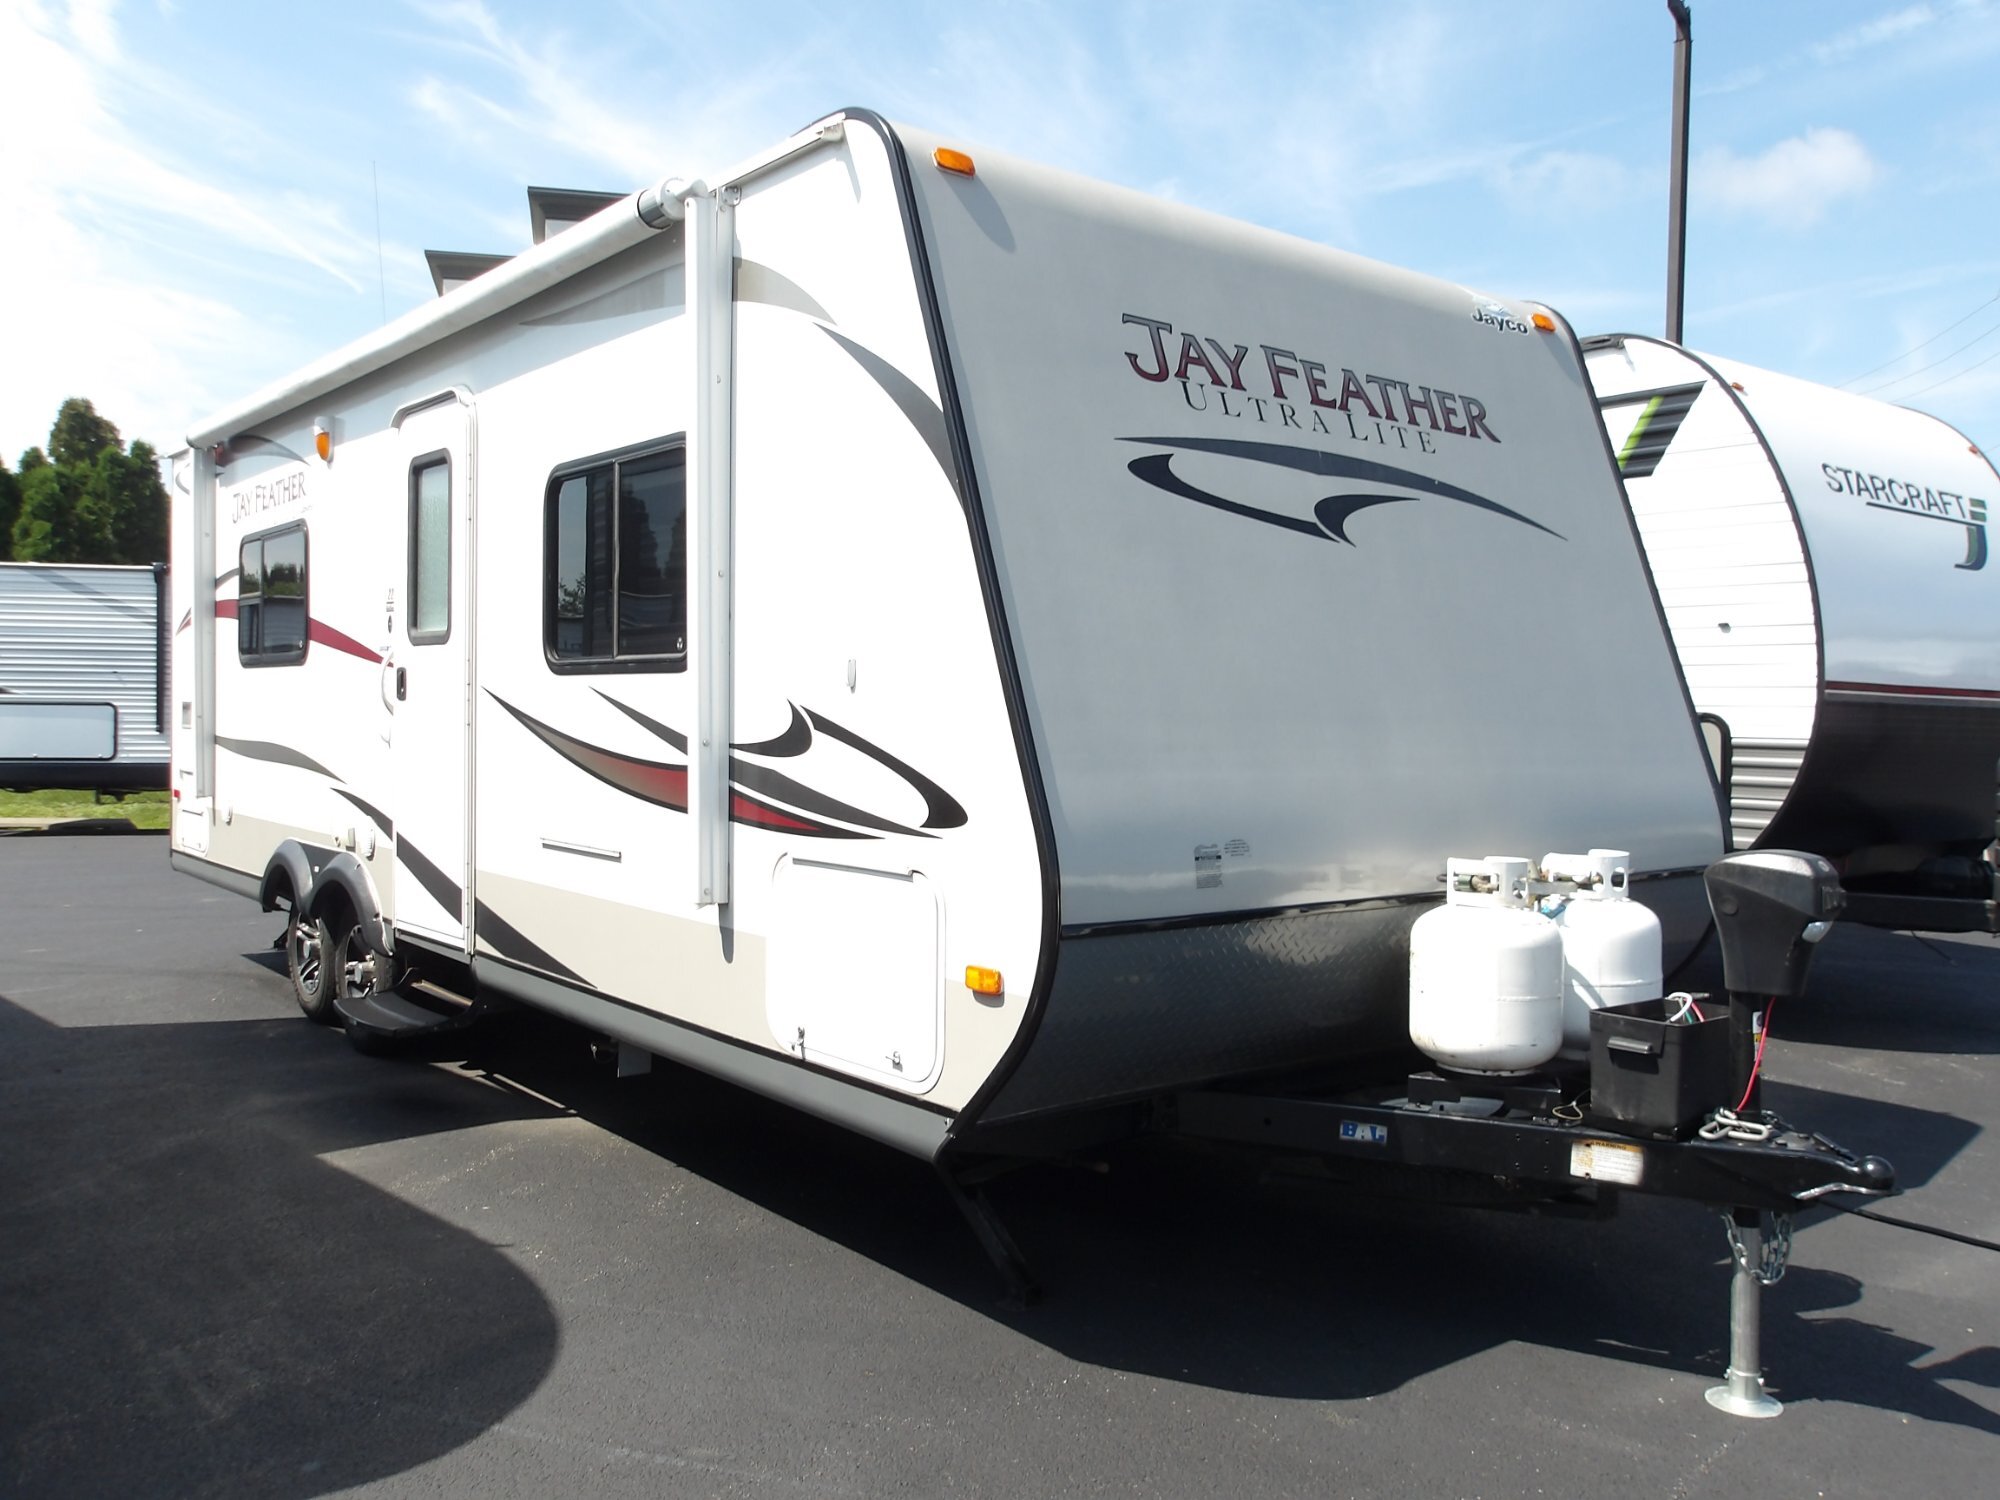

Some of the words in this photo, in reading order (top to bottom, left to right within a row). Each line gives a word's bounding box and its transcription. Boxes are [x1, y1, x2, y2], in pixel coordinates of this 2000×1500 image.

[1472, 307, 1529, 334] Jayco
[1121, 313, 1248, 392] JAY
[1259, 344, 1502, 443] FEATHER
[1178, 380, 1331, 435] ULTRA
[1345, 413, 1437, 455] LITE
[232, 490, 253, 524] JAY
[255, 471, 307, 513] FEATHER
[1821, 462, 1967, 519] STARCRAFT
